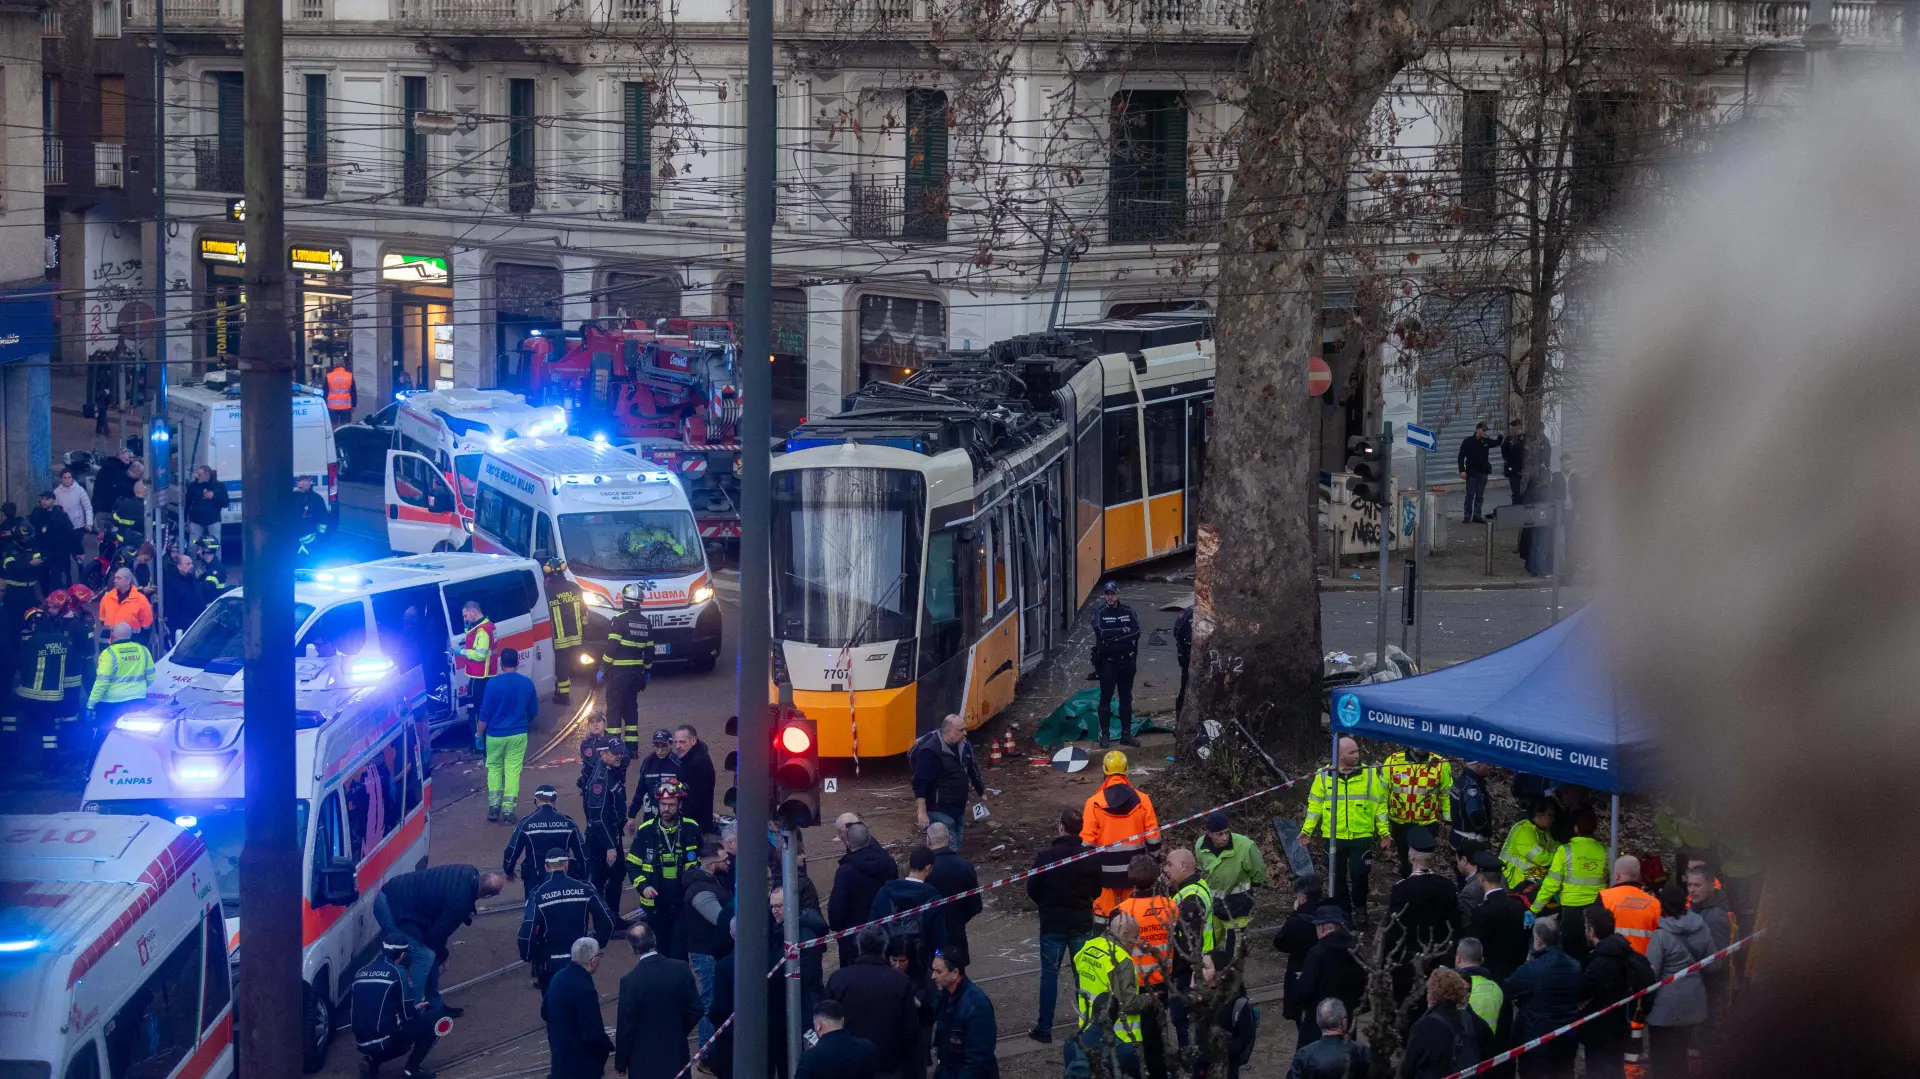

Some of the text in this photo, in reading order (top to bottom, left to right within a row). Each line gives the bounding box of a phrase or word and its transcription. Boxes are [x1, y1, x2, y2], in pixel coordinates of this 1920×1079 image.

[486, 463, 534, 494] CROCE MEDICA MILANO
[823, 669, 850, 680] 7707
[1368, 710, 1609, 770] COMUNE DI MILANO PROTEZIONE CIVILE
[116, 777, 153, 786] ANPAS
[826, 780, 835, 790] A
[975, 805, 982, 816] 2
[541, 888, 585, 901] POLIZIA LOCALE
[369, 970, 391, 978] LOCALE
